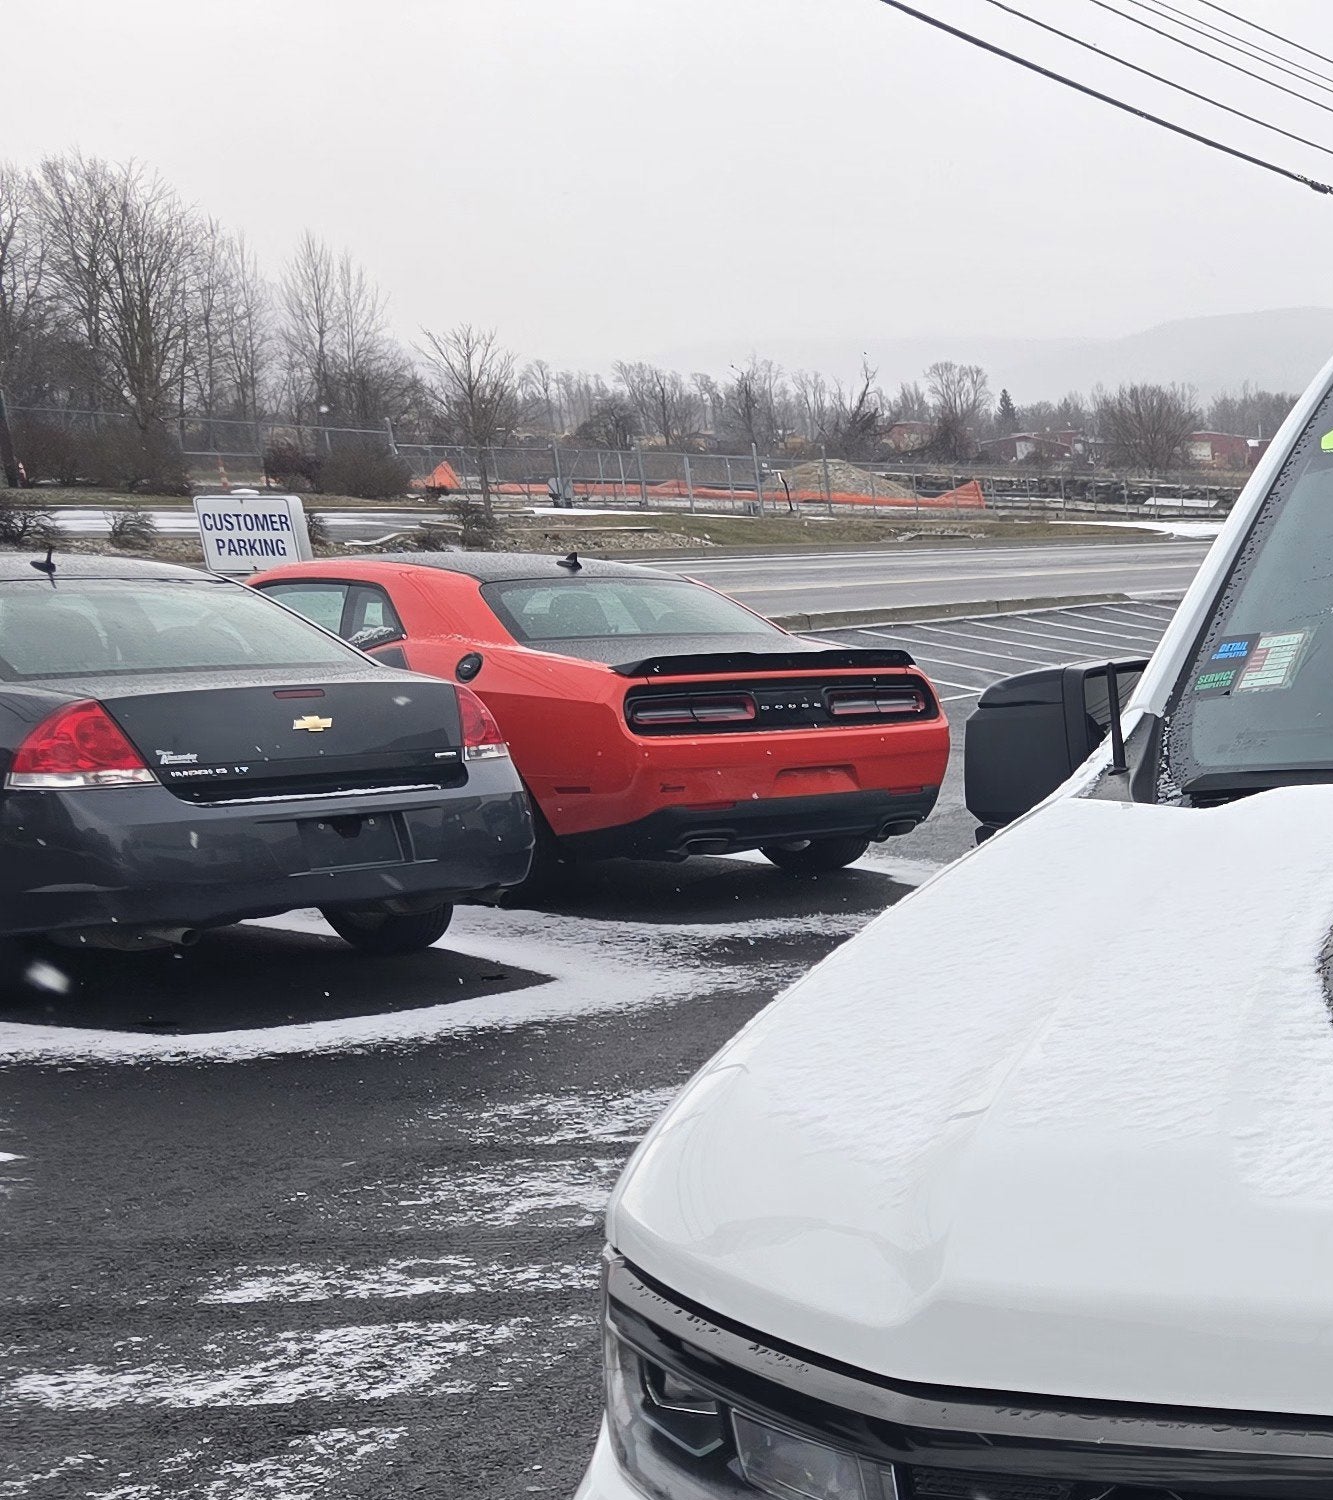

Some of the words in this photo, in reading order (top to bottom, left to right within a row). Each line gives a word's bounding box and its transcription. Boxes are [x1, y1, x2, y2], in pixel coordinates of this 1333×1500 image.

[201, 512, 291, 532] CUSTOMER
[215, 538, 287, 557] PARKING
[1218, 641, 1249, 653] DETAIL
[1197, 669, 1237, 684] SERVICE
